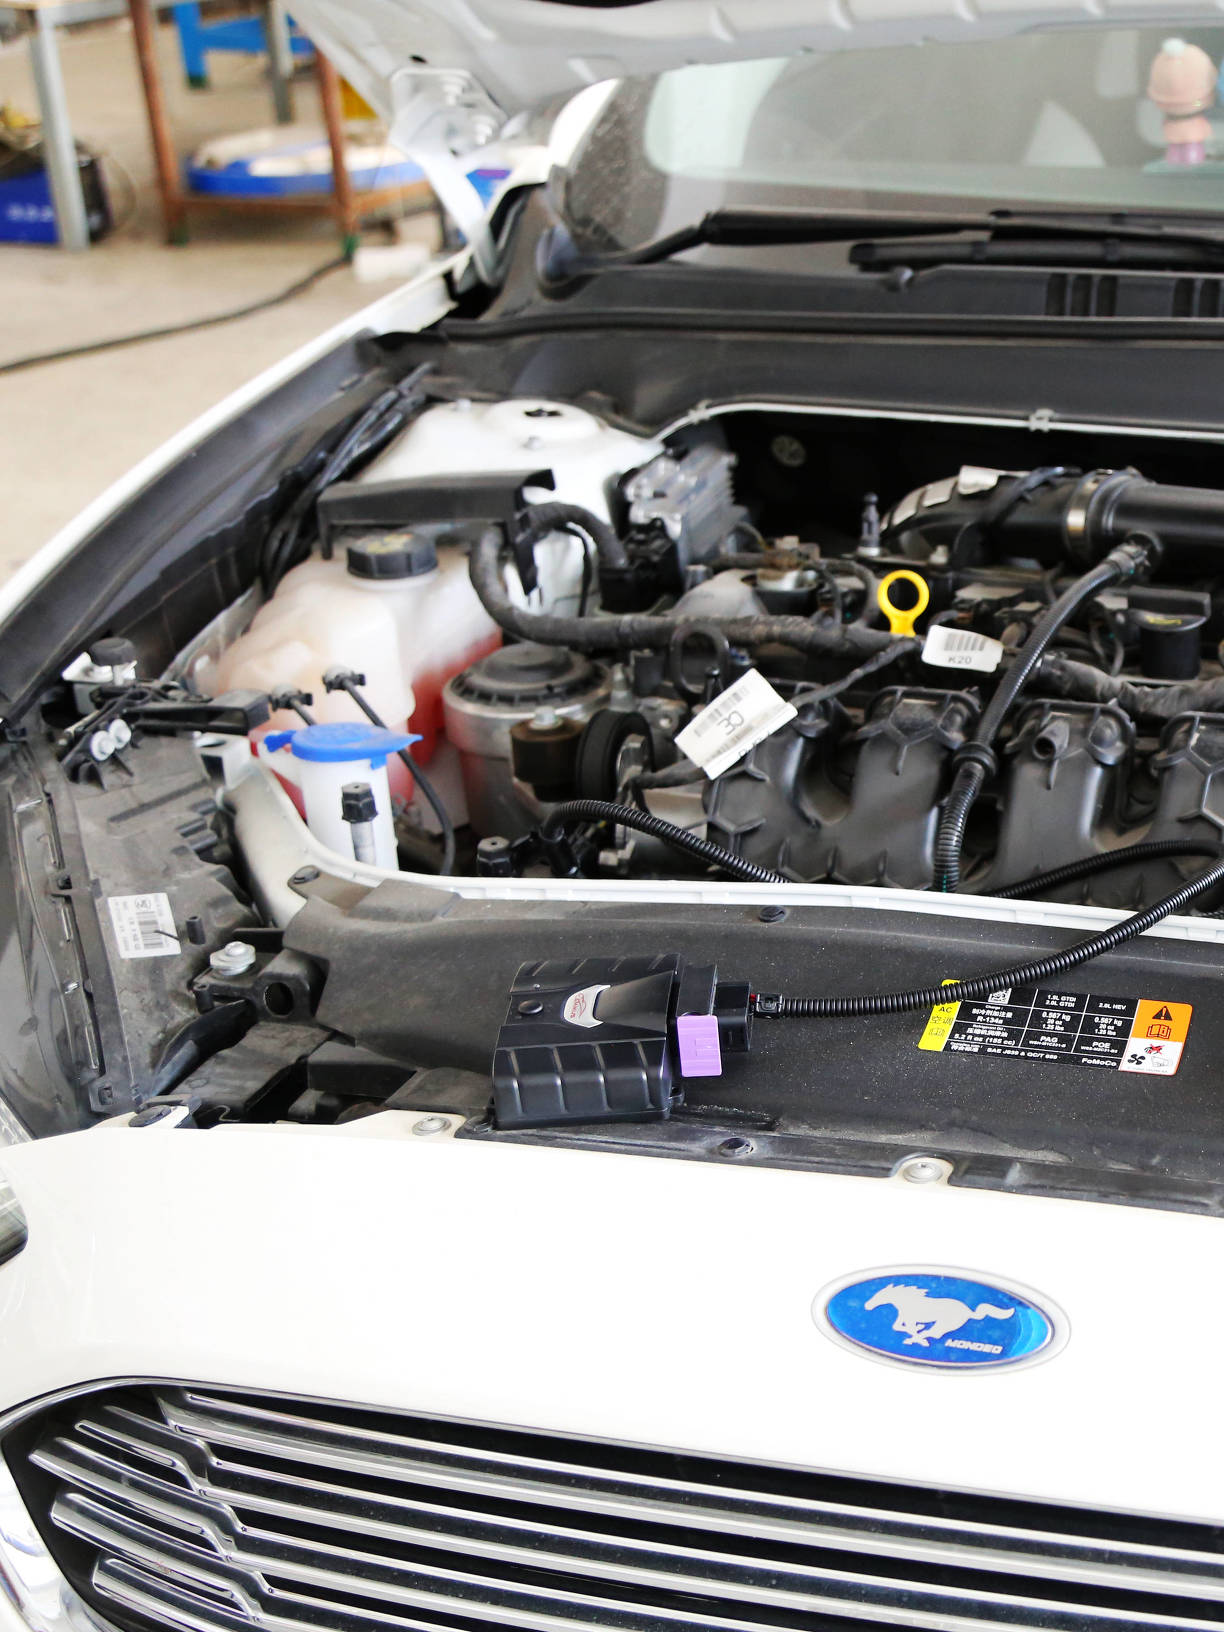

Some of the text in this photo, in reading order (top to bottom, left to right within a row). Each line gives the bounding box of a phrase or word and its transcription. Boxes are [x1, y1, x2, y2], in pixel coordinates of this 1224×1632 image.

[977, 1015, 1004, 1024] R-134a
[1062, 1013, 1071, 1022] kg
[1113, 1018, 1123, 1027] kg
[1040, 1035, 1059, 1043] PAG
[1092, 1041, 1111, 1049] POE
[1081, 1057, 1117, 1067] FoMoCo
[944, 1338, 1004, 1354] MONDEO
